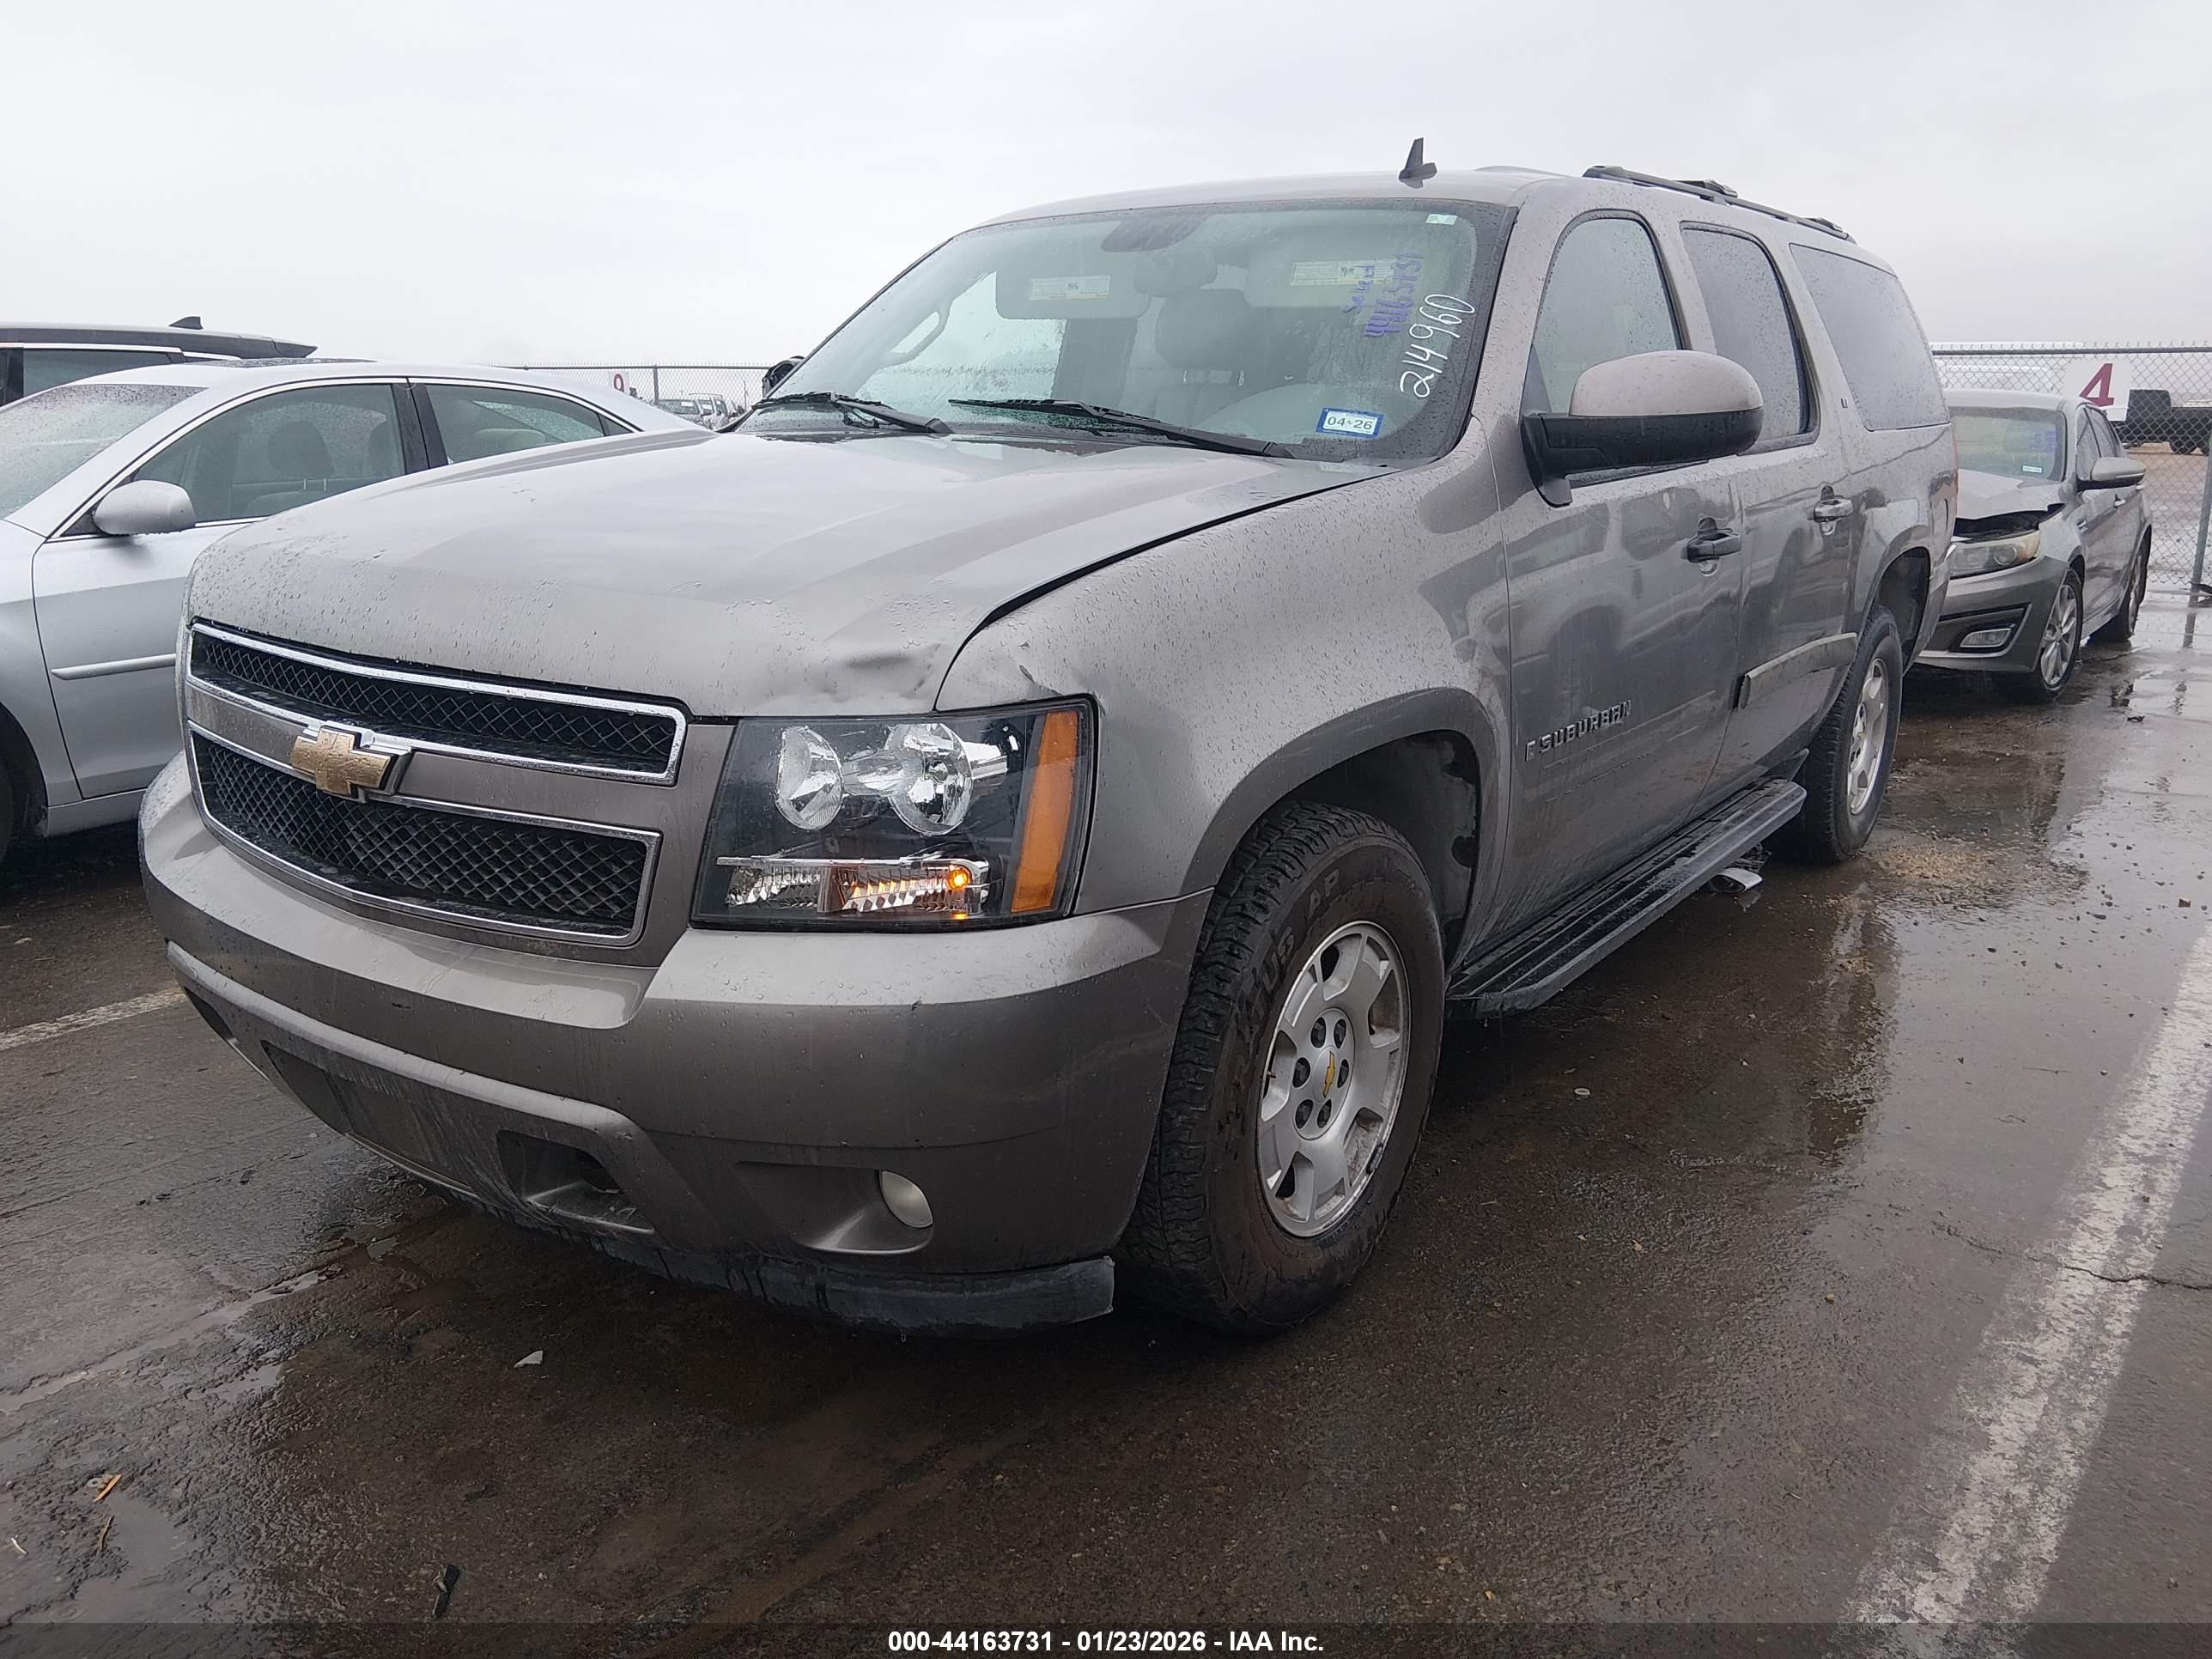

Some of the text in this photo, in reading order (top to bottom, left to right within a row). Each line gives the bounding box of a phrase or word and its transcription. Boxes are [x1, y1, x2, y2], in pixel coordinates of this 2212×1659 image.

[1400, 294, 1475, 398] 214960
[2078, 362, 2115, 407] 4
[1539, 699, 1632, 753] SUBURBAN
